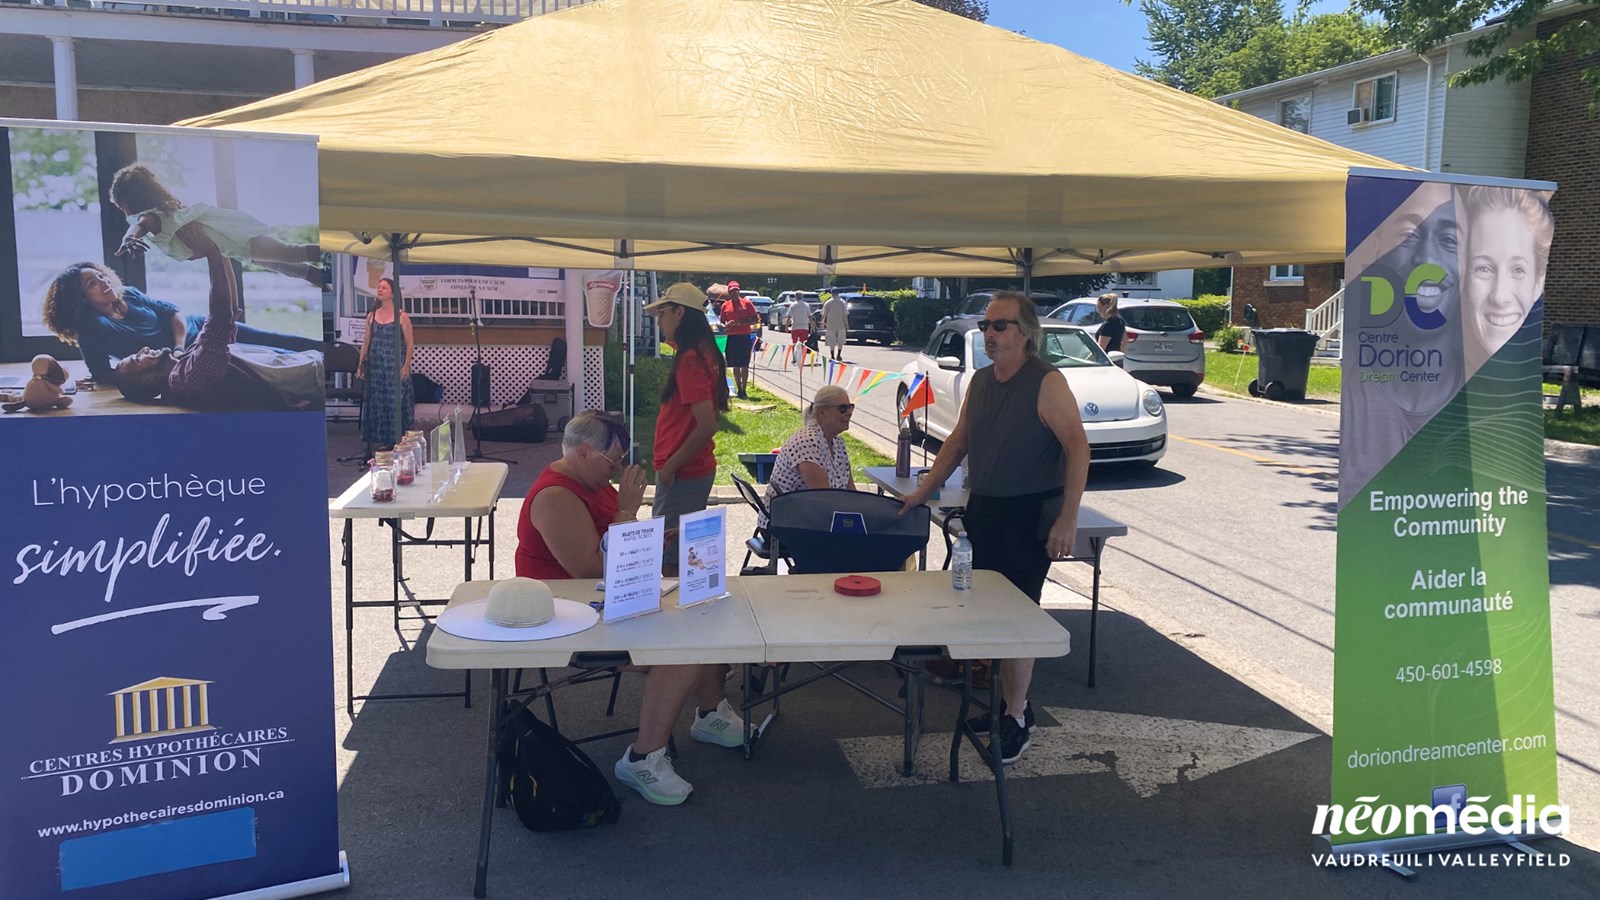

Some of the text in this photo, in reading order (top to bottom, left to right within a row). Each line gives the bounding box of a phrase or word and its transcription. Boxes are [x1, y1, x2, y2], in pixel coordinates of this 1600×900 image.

[1358, 331, 1399, 344] Centre
[1358, 344, 1442, 368] Dorion
[1359, 370, 1440, 383] Dream Center
[32, 473, 267, 510] L'hypothèque
[1370, 485, 1529, 515] Empowering the
[1393, 513, 1506, 538] Community
[12, 513, 282, 603] simplifiée.
[1411, 566, 1487, 591] Aider la
[1384, 591, 1514, 620] communauté
[1395, 658, 1503, 684] 450-601-4598
[29, 726, 289, 775] CENTRES HYPOTHÉCAIRES
[1347, 733, 1547, 769] doriondreamcenter.com
[60, 747, 263, 797] DOMINION
[37, 788, 285, 839] www.hypothecairesdominion.ca
